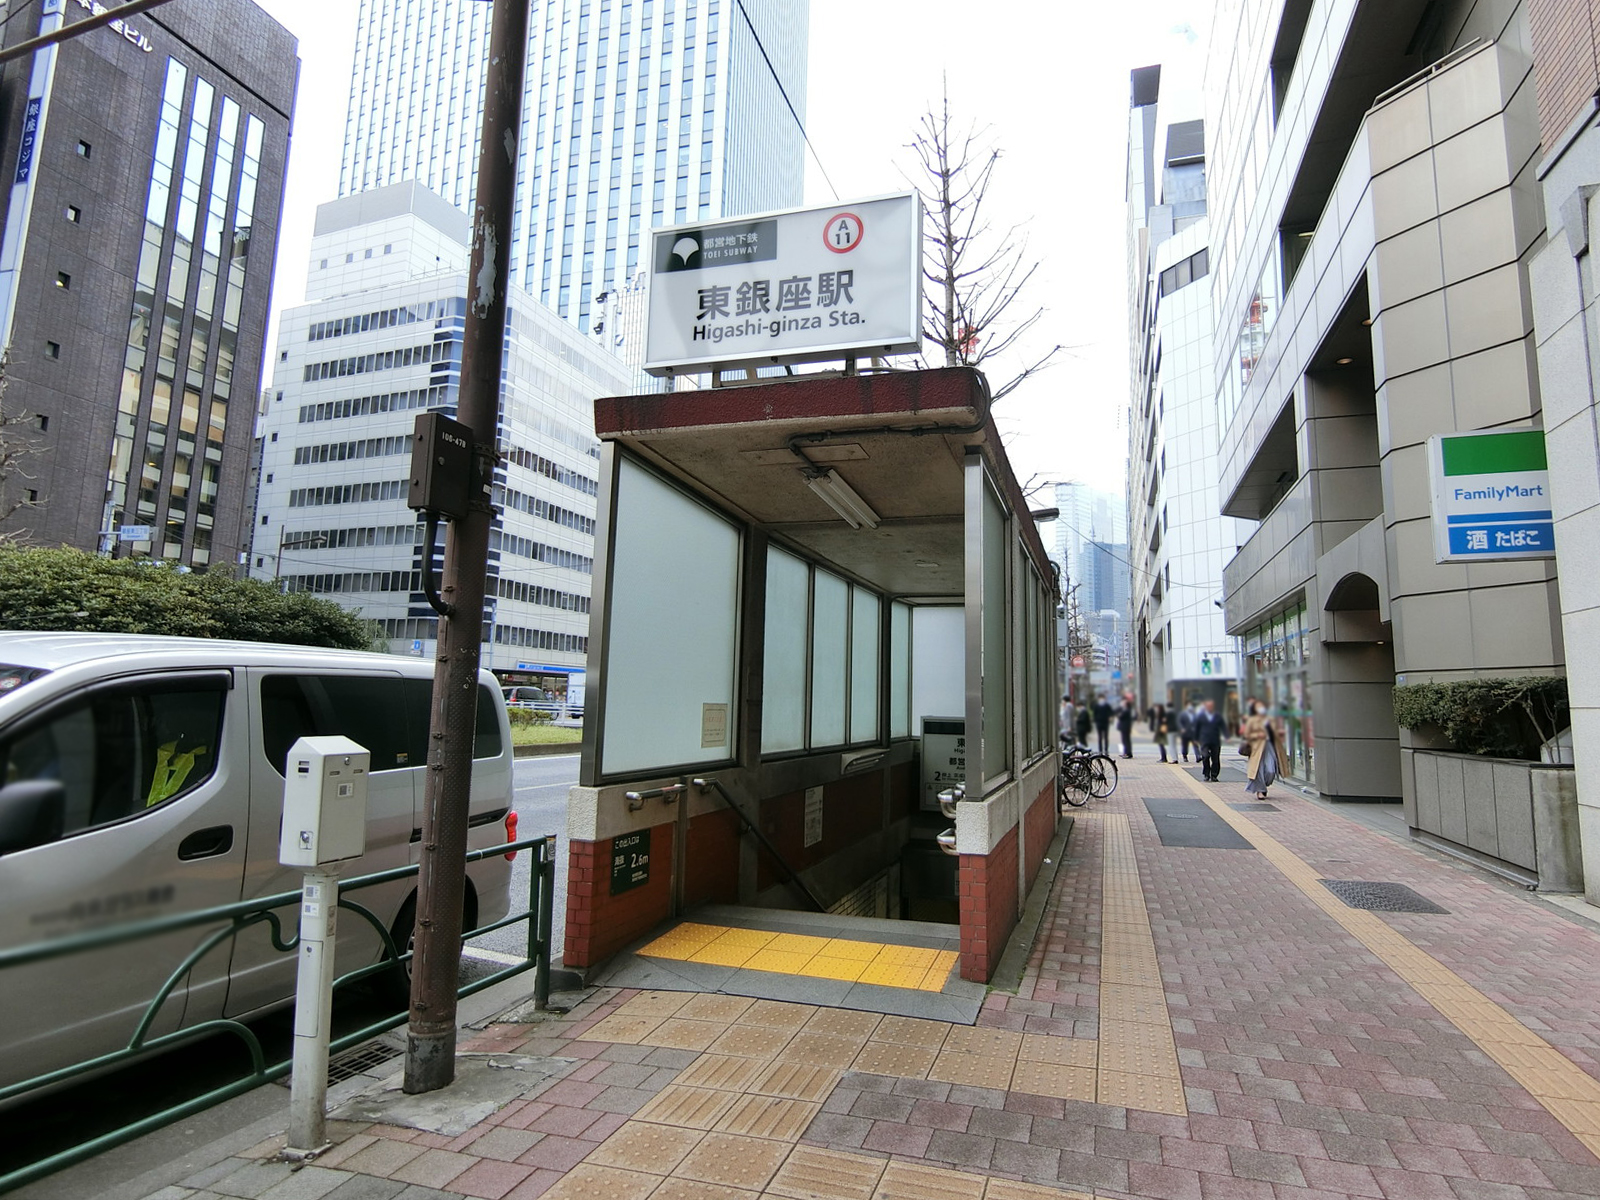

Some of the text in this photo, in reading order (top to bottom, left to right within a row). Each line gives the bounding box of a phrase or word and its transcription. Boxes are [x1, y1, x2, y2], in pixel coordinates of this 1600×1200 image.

[19, 103, 40, 178] 銀座コジマ
[838, 219, 849, 231] A
[703, 232, 759, 250] 都営地下鉄
[835, 232, 851, 245] 11
[703, 245, 759, 260] TOEI SUBWAY
[696, 269, 854, 321] 東銀座駅
[693, 310, 866, 343] Higashi-ginza Sta.
[1454, 485, 1544, 501] FamilyMart
[1466, 530, 1541, 550] 酒 たばこ
[631, 853, 649, 869] 2.6m
